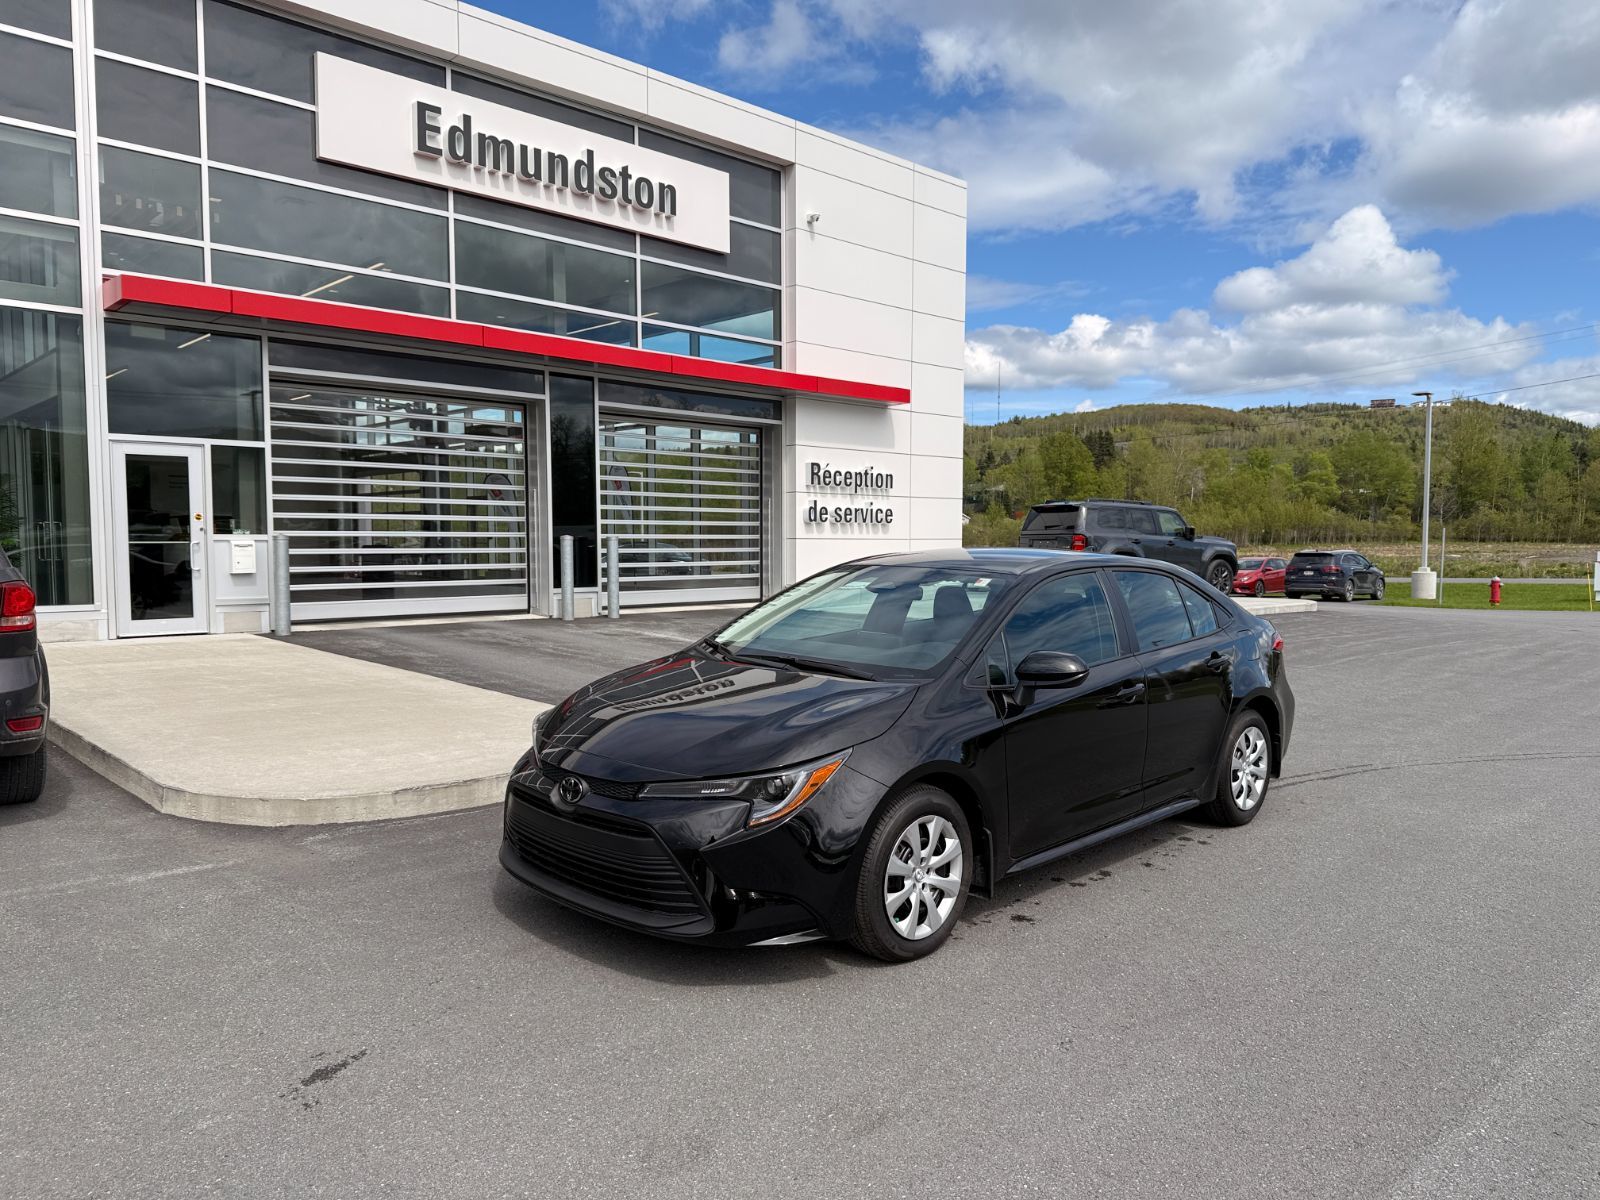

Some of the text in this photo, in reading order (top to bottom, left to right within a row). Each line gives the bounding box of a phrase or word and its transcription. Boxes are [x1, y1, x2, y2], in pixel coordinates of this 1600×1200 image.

[415, 100, 677, 217] Edmundston
[810, 462, 894, 493] Réception
[808, 500, 893, 524] de service
